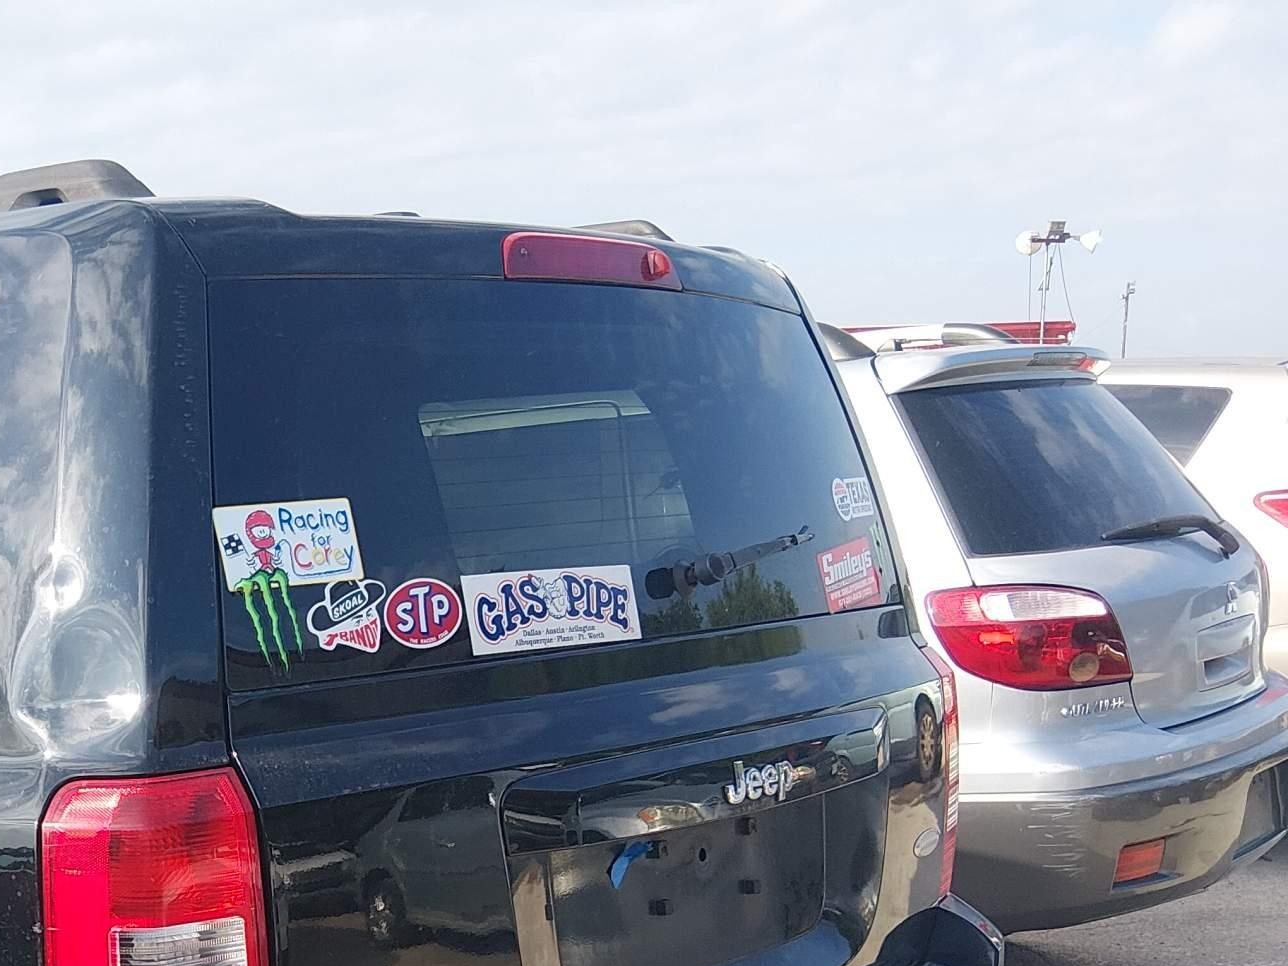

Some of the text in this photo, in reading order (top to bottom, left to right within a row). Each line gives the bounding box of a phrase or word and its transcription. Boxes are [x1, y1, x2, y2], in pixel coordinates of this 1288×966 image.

[278, 507, 349, 535] Racing
[311, 533, 331, 549] for
[294, 543, 353, 571] Corey
[333, 593, 364, 619] SKOAL
[395, 585, 450, 633] STP
[476, 574, 629, 642] GAS PIPE
[514, 637, 554, 647] Albuquerque
[557, 634, 574, 642] Plano
[588, 631, 605, 640] Worth
[522, 624, 596, 637] Dallas Austin Arlington
[724, 760, 794, 805] Jeep
